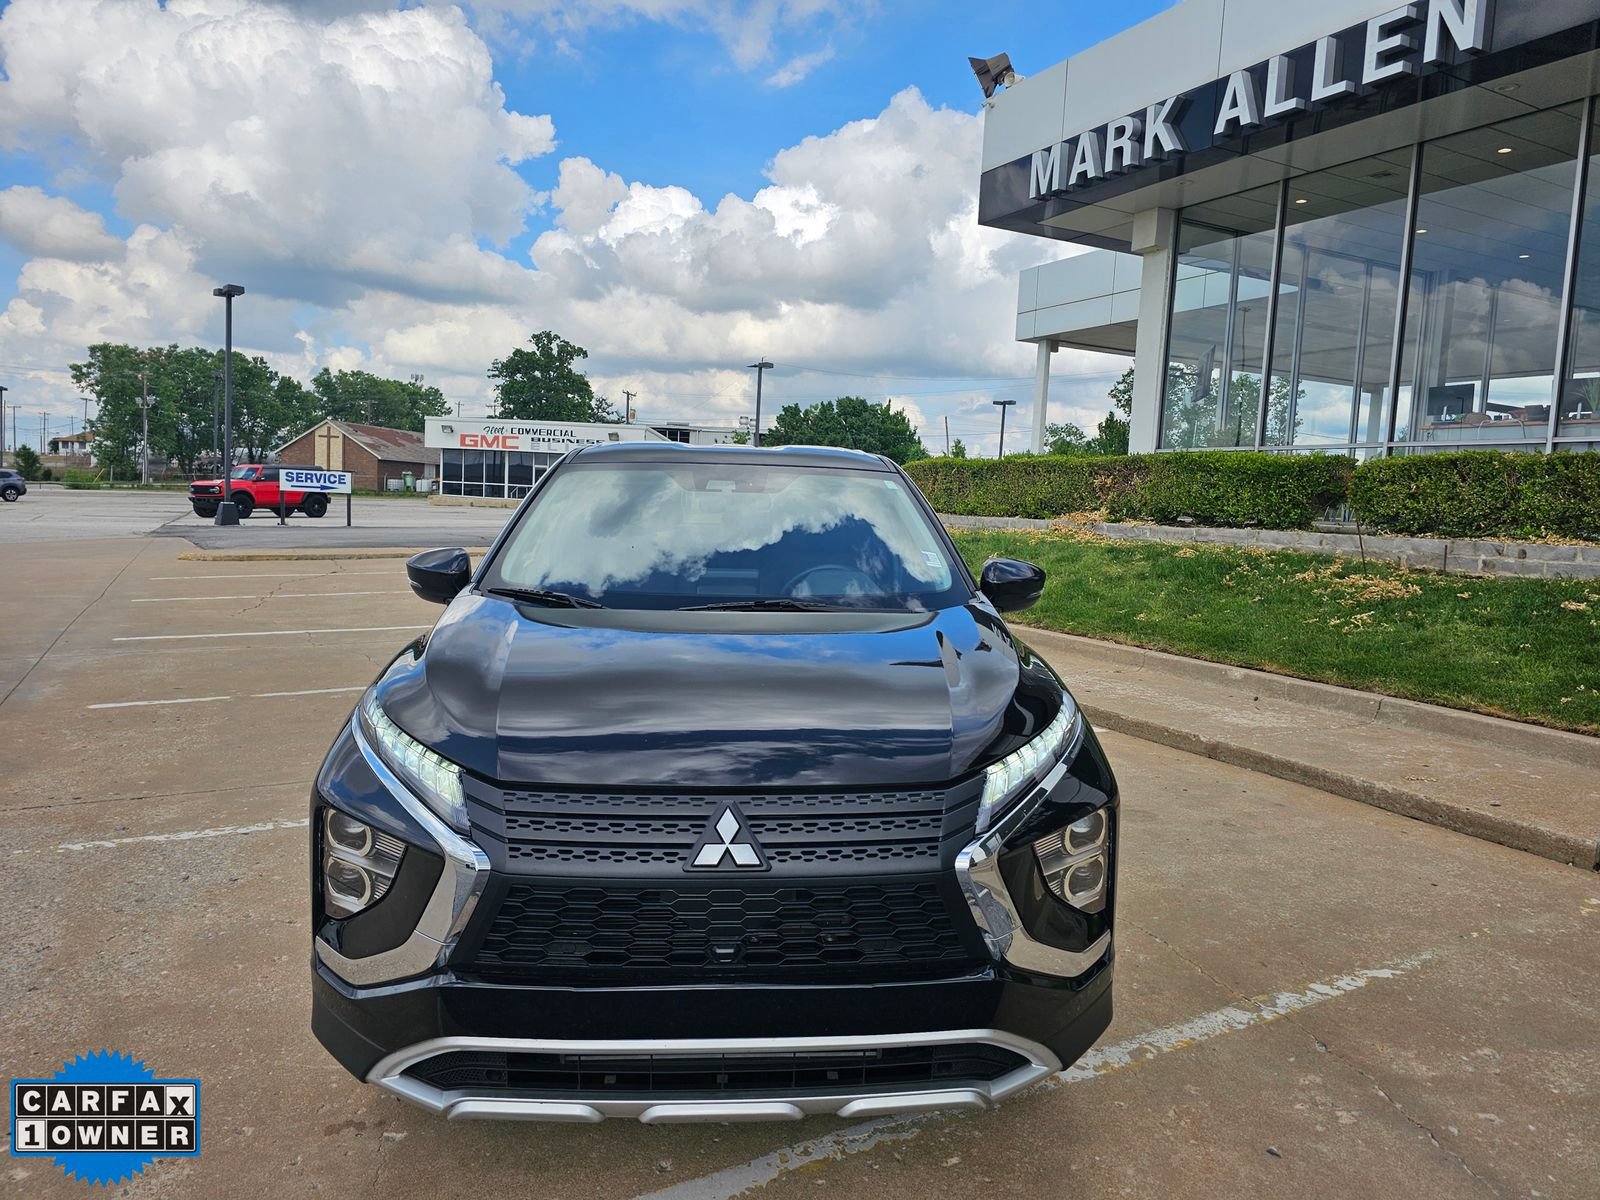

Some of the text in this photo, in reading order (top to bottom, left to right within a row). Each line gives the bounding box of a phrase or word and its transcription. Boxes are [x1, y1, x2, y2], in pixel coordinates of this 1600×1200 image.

[1029, 0, 1489, 200] MARK ALLEN
[483, 425, 577, 437] Fleet COMMERCIAL
[460, 434, 519, 449] GMC
[285, 471, 346, 484] SERVICE
